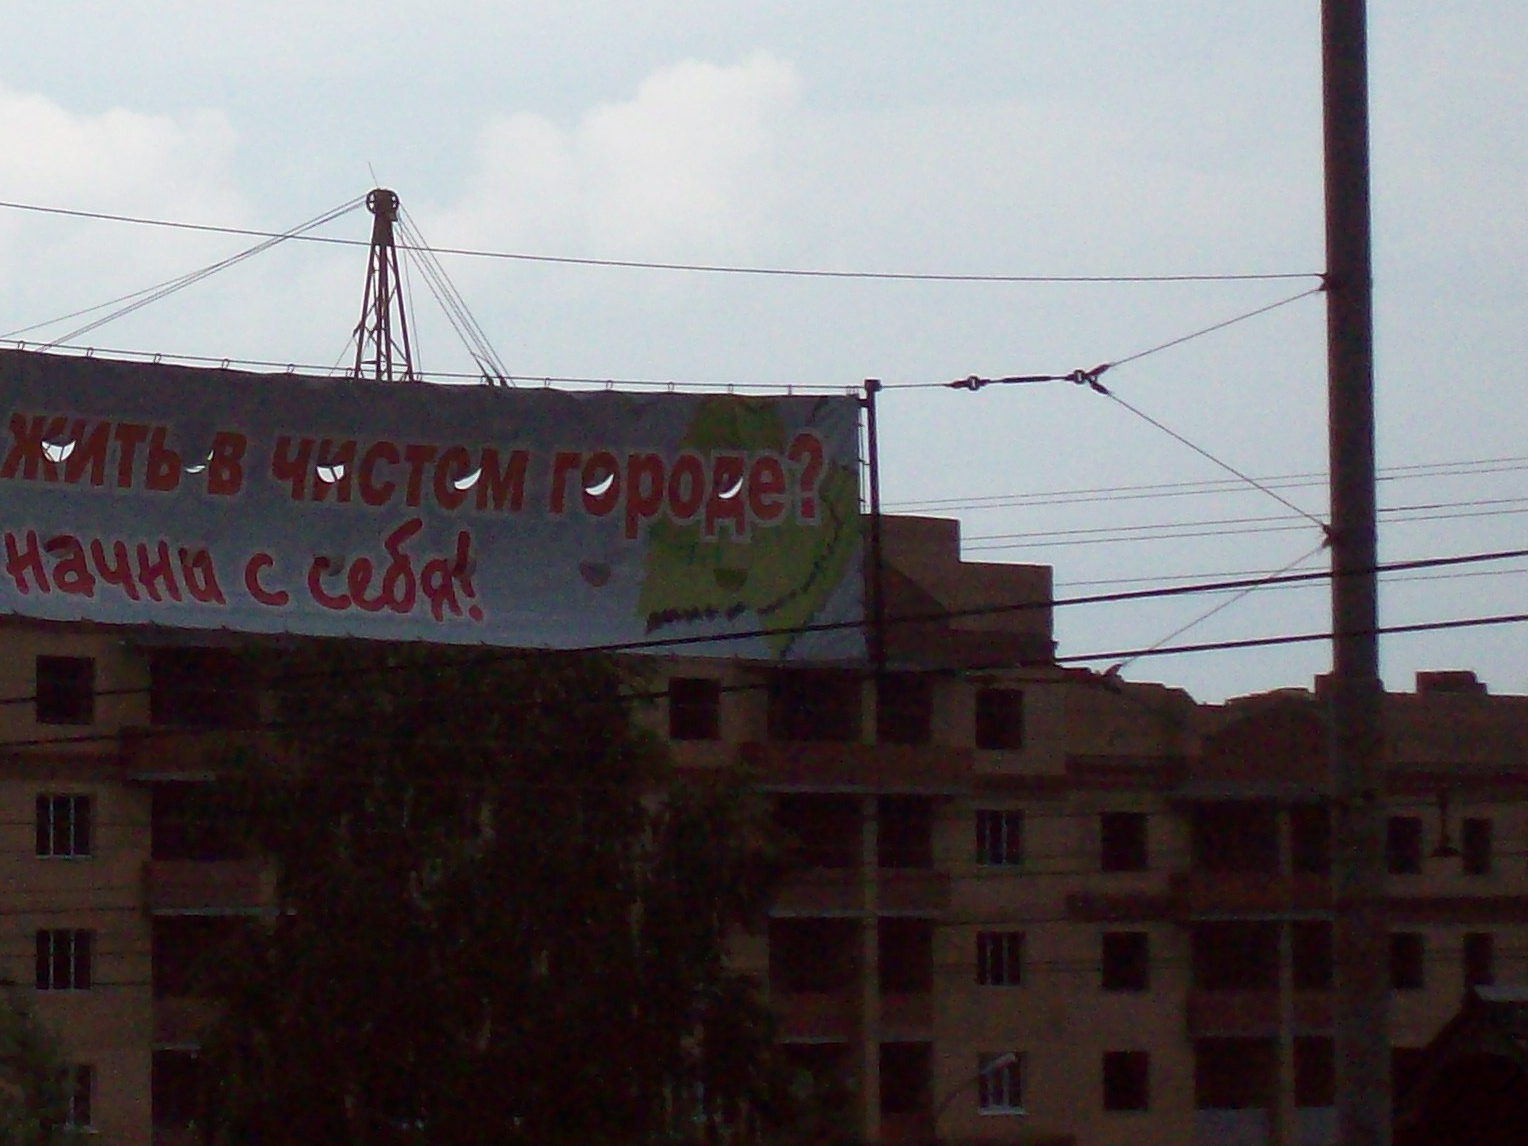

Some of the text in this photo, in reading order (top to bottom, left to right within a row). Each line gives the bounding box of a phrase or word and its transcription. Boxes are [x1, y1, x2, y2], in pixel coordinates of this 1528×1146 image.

[0, 413, 180, 491] жить
[208, 431, 247, 494] в
[272, 436, 529, 512] чистом
[550, 433, 823, 539] городе?
[4, 518, 483, 622] начни с себя!
